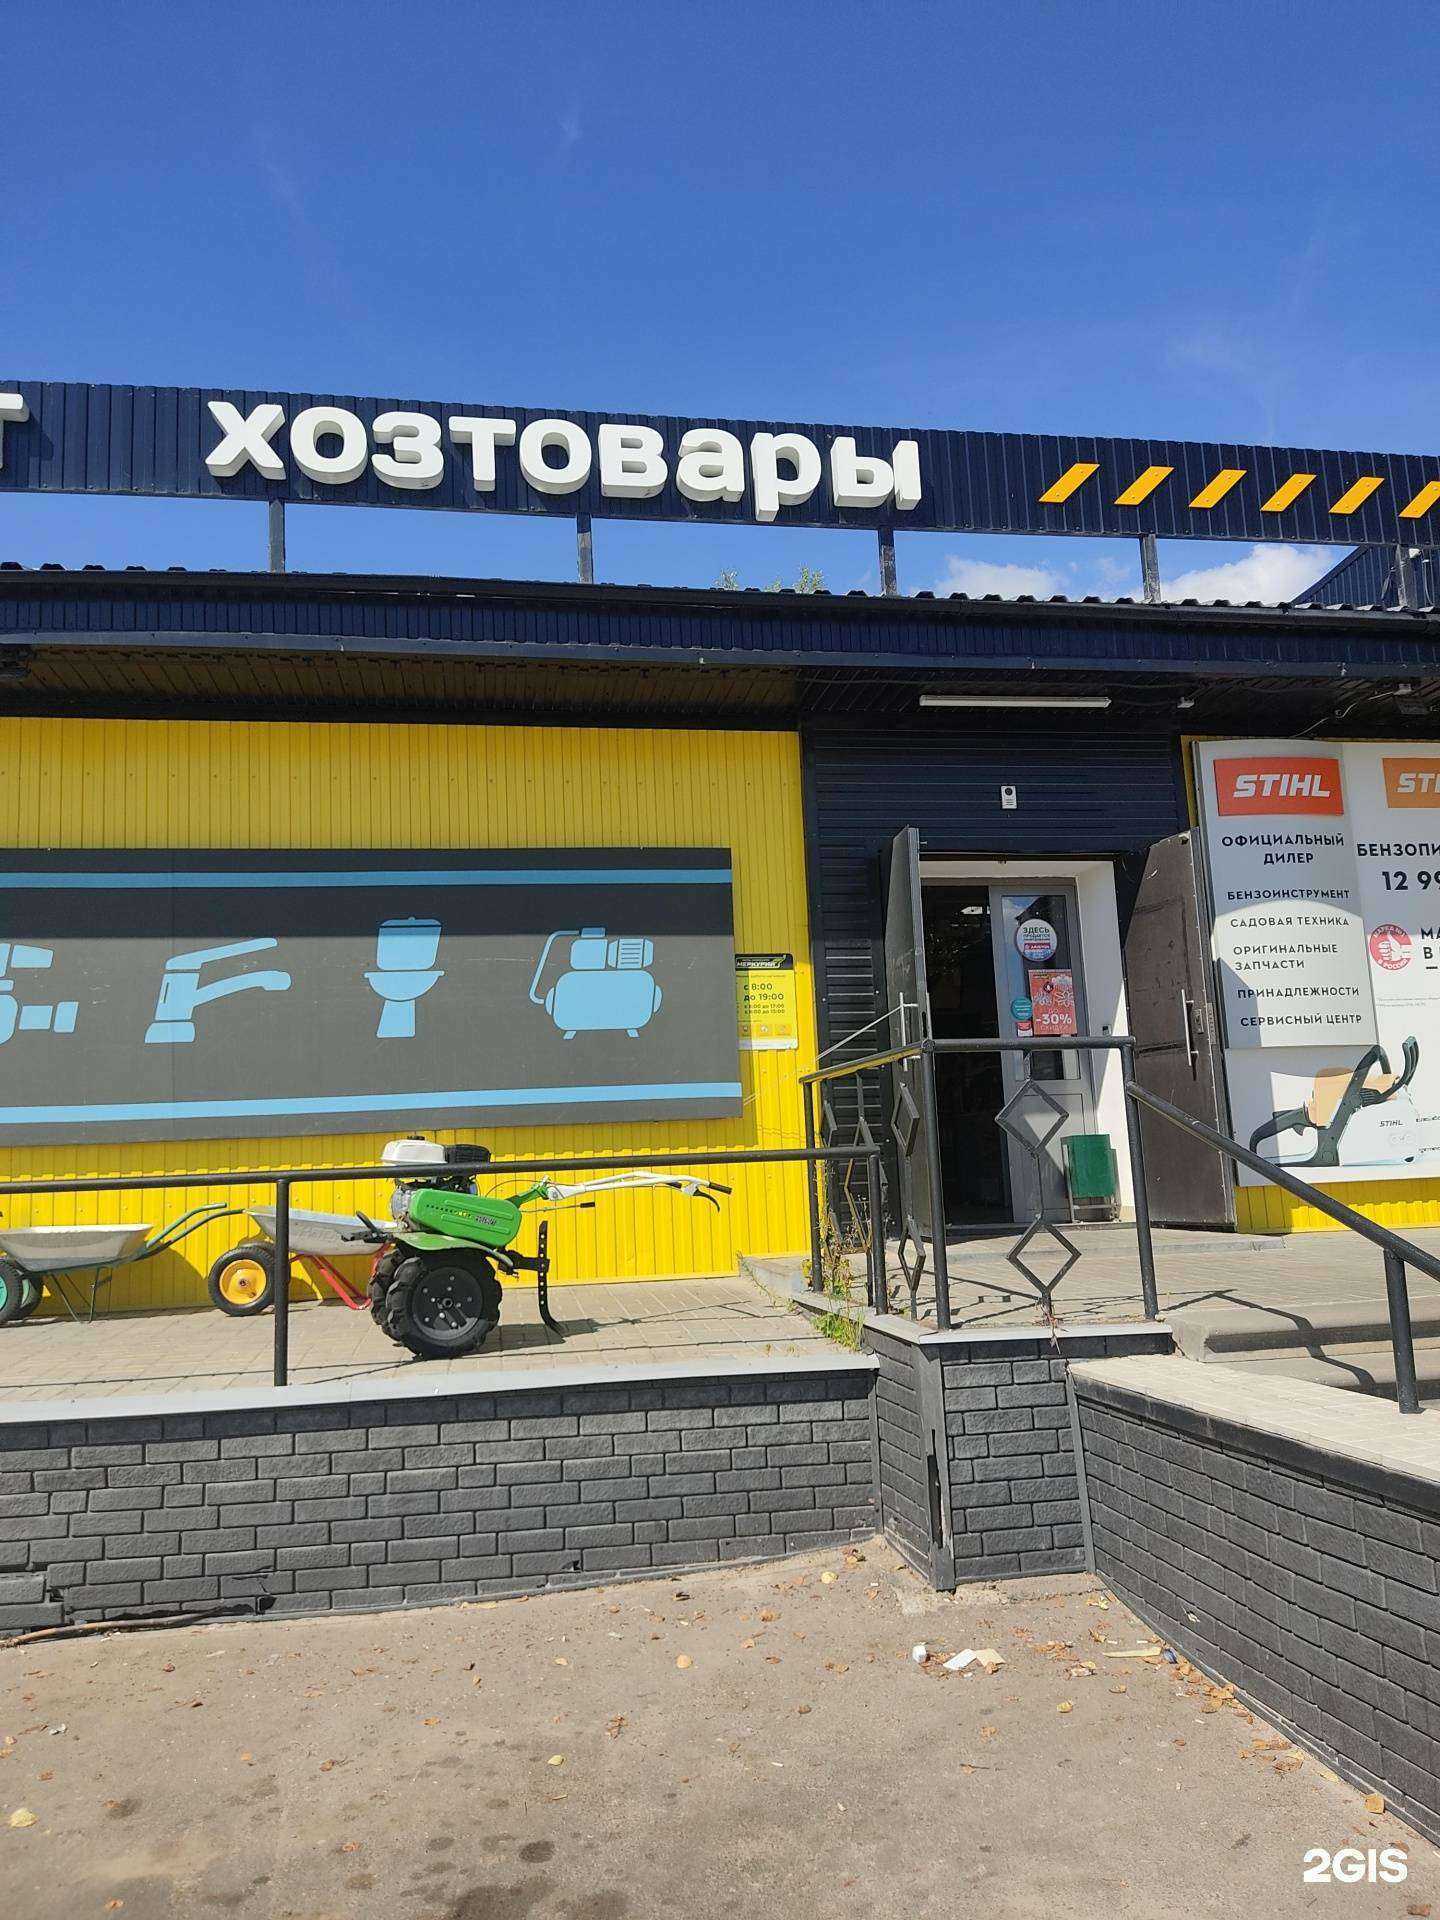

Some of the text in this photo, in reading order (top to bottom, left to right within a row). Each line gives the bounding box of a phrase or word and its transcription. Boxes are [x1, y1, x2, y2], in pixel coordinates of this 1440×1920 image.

[206, 400, 921, 523] хозтовары
[1233, 774, 1330, 798] STIHL
[1221, 833, 1344, 847] ОФИЦИАЛЬНЫЙ
[1263, 852, 1314, 865] ДИЛЕР
[1382, 871, 1409, 890] 12
[1227, 889, 1350, 901] БЕНЗОИНСТРУМЕНТ
[1230, 916, 1350, 928] САДОВАЯ ТЕХНИКА
[1023, 926, 1049, 934] ЗДЕСЬ
[1233, 944, 1338, 955] ОРИГИНАЛЬНЫЕ
[1423, 947, 1433, 959] В
[1235, 960, 1305, 971] ЗАПЧАСТИ
[1237, 987, 1360, 999] ПРИНАДЛЕЖНОСТИ
[1035, 1013, 1072, 1025] -30%
[1240, 1013, 1362, 1027] СЕРВИСНЫЙ ЦЕНТР
[1379, 1120, 1403, 1128] STIHL
